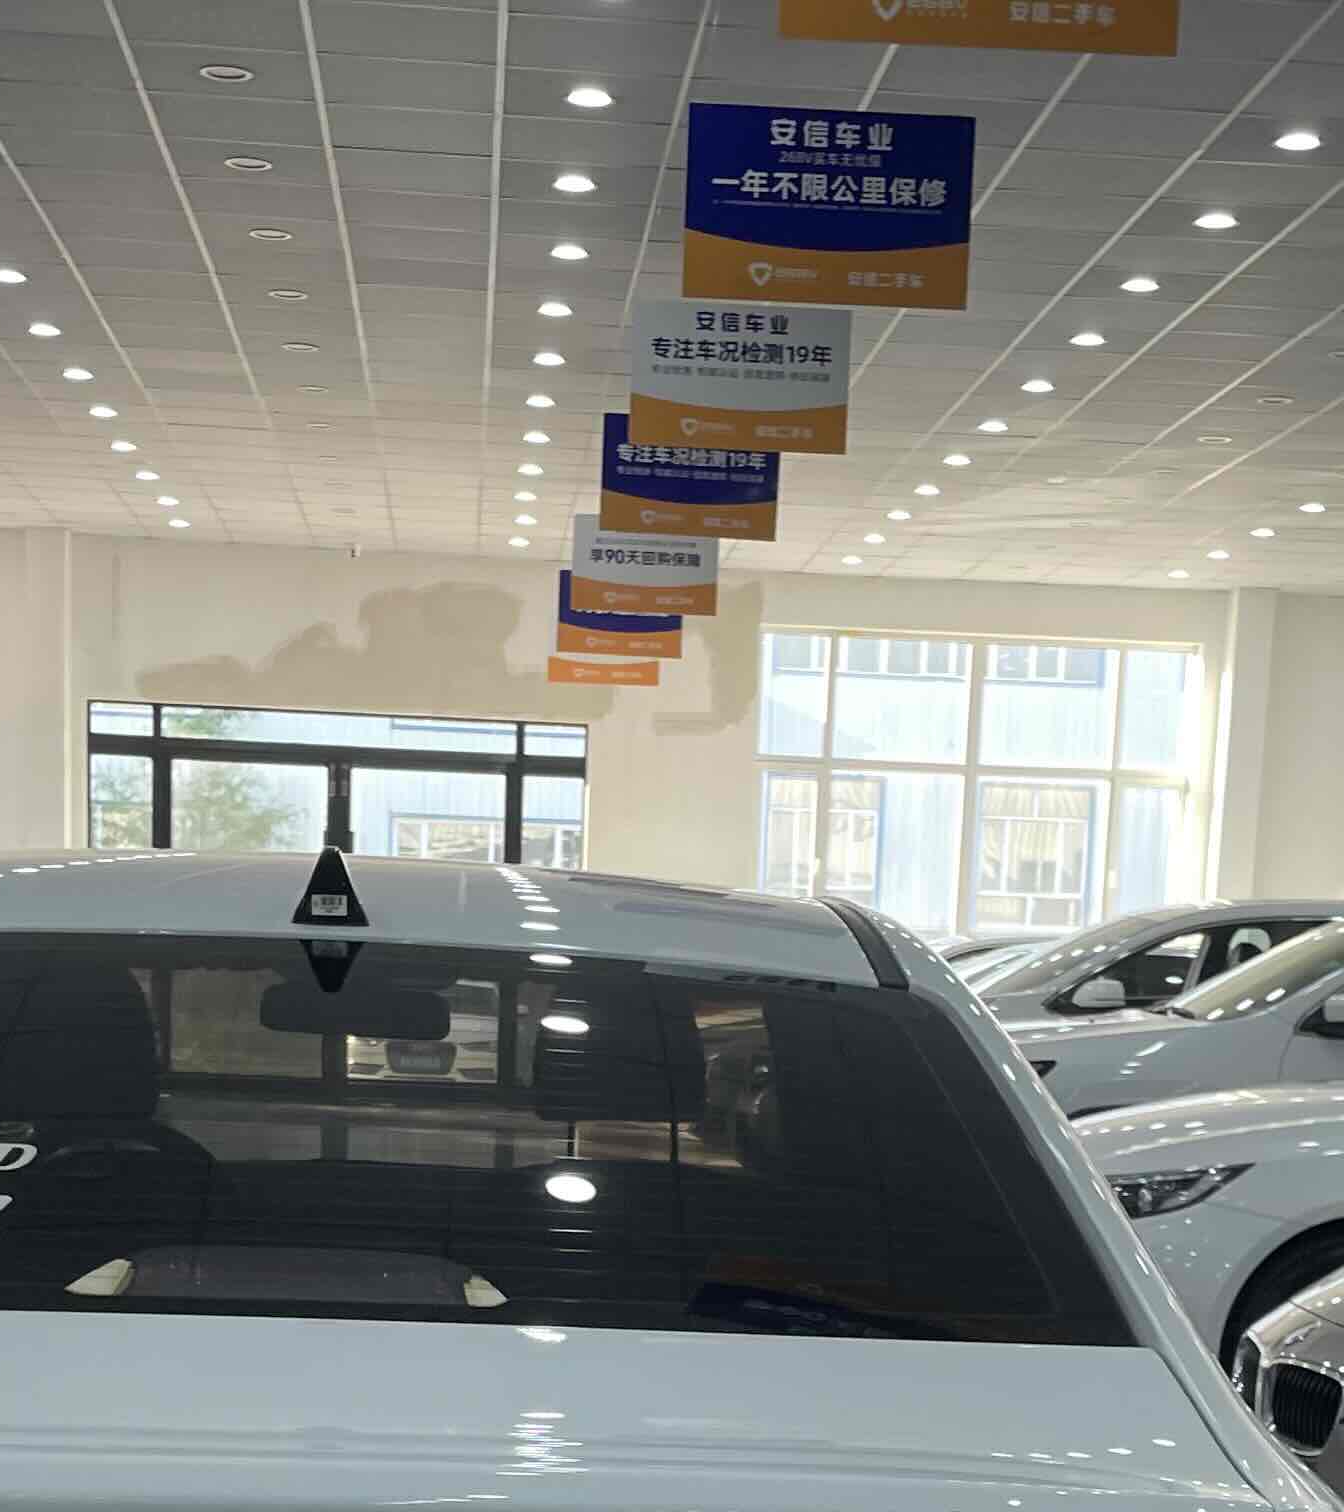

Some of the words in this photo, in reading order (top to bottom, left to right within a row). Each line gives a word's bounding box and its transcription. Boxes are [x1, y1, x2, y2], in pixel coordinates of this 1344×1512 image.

[770, 117, 895, 151] 安信车业
[712, 168, 948, 208] 一年不限公里保修
[696, 310, 790, 336] 安信车业
[650, 336, 834, 368] 专注车况检测19年
